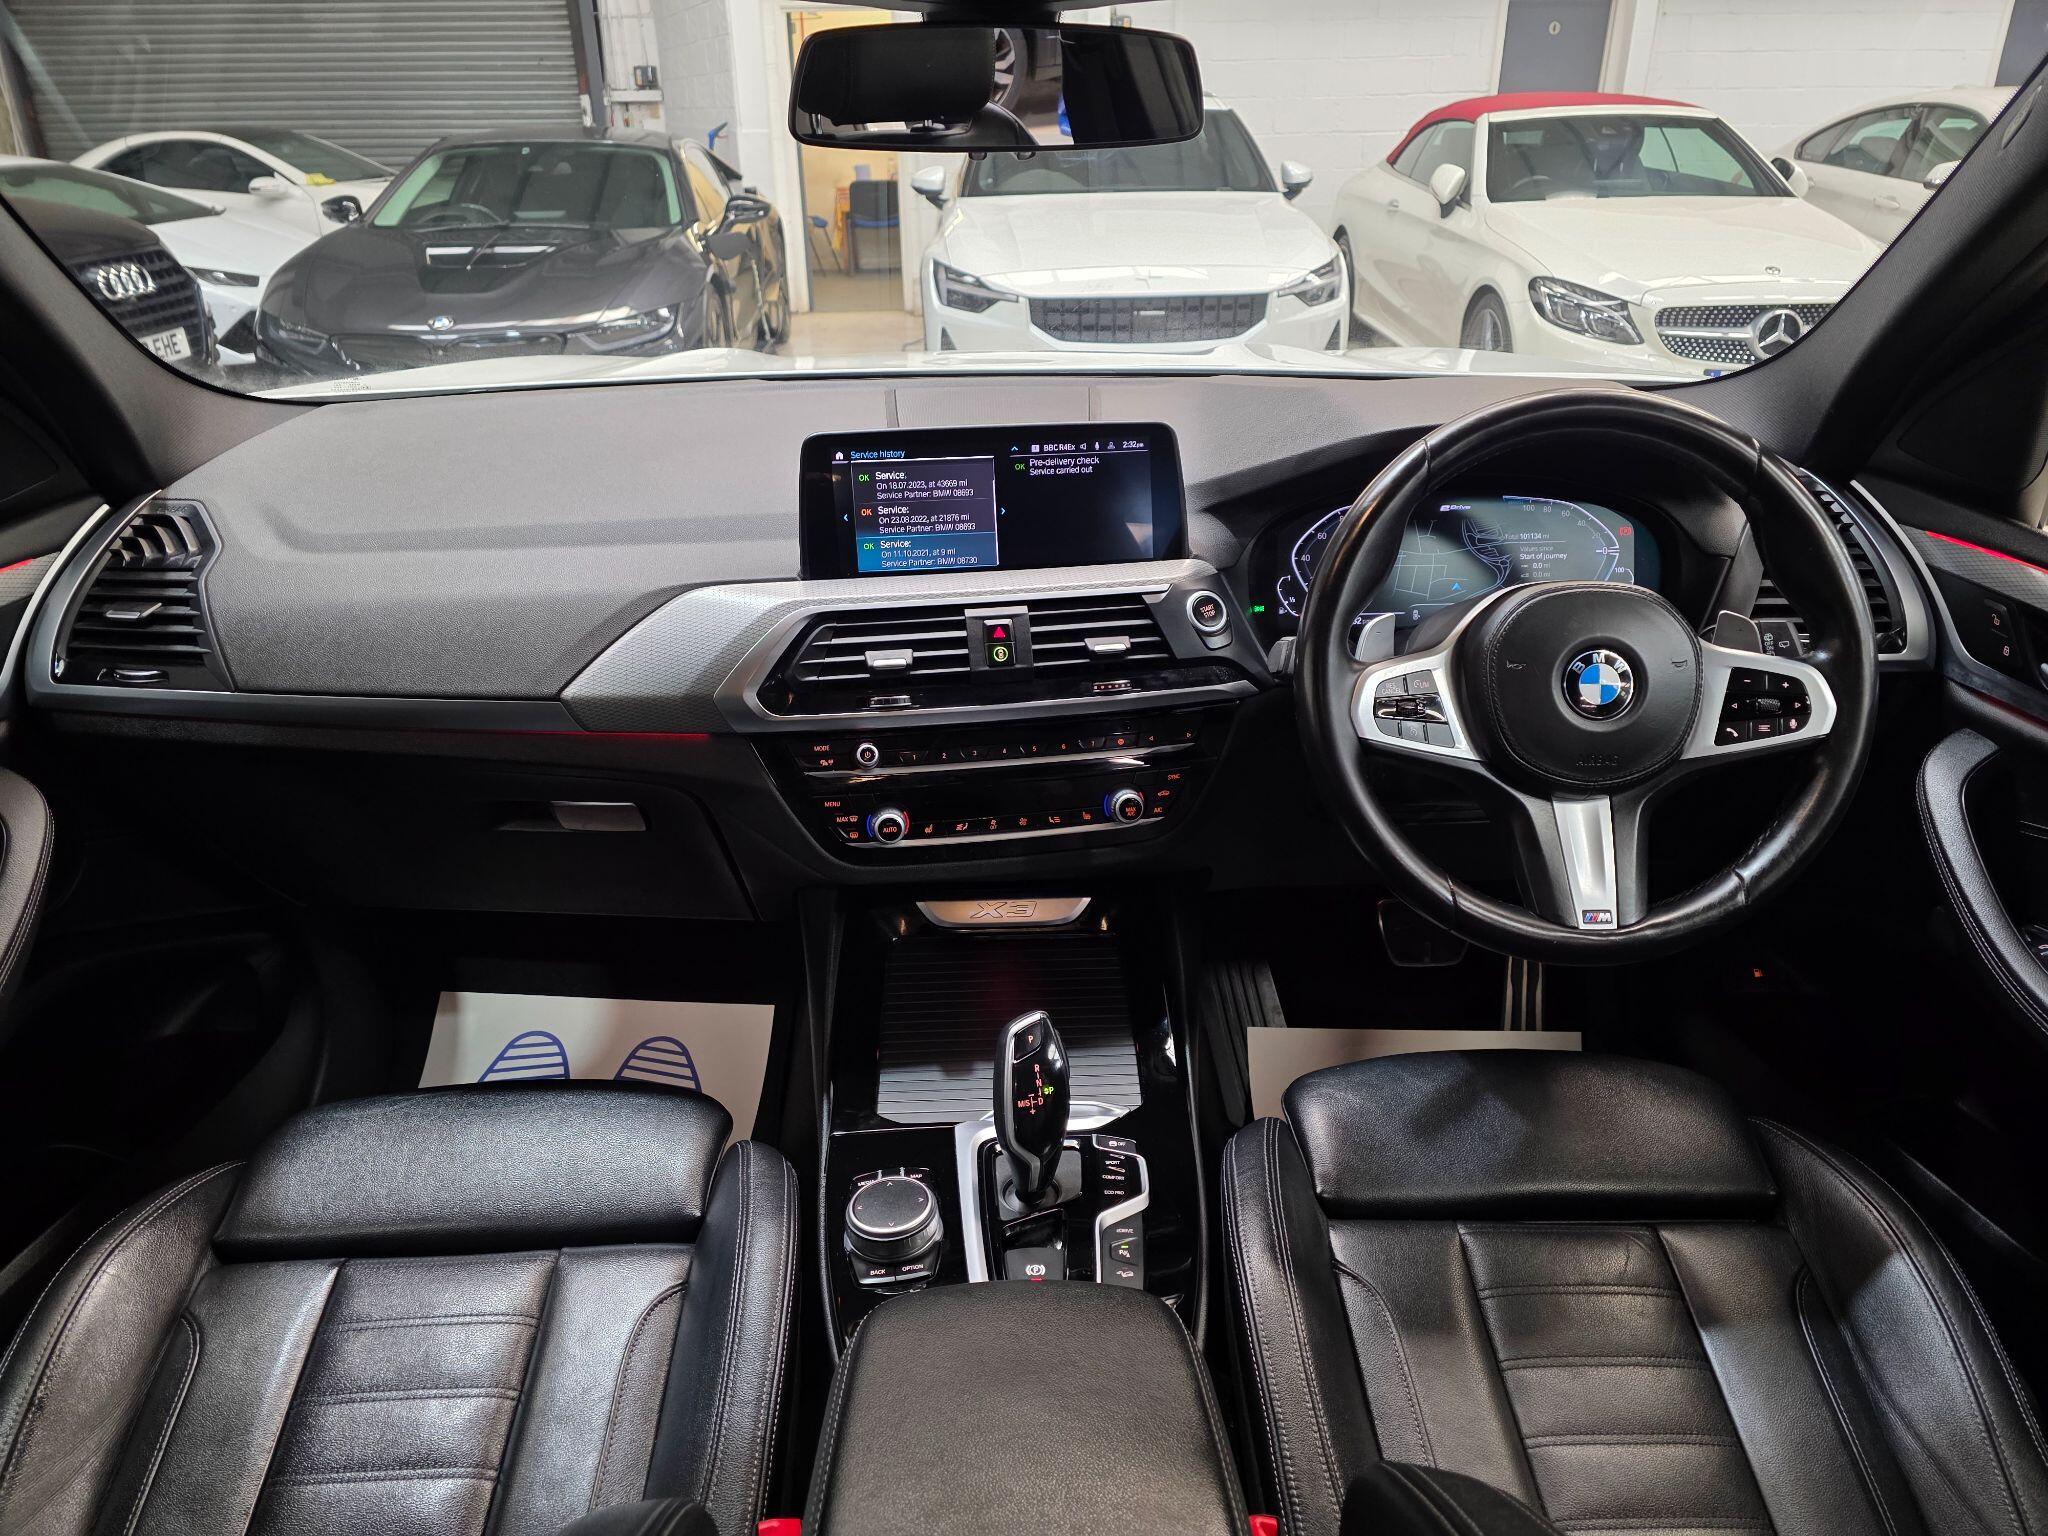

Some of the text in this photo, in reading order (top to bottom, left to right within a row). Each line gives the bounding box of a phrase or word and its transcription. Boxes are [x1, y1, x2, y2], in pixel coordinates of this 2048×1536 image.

[1043, 443, 1059, 452] BBC
[850, 449, 906, 459] Service history
[1029, 456, 1100, 467] Pre-delivery check
[1014, 463, 1026, 471] OK
[1029, 465, 1093, 476] Service carried out
[858, 474, 870, 482] OK
[875, 471, 907, 480] Service:
[876, 482, 888, 490] On
[928, 480, 936, 488] at
[958, 478, 968, 487] mi
[876, 491, 903, 500] Service
[932, 489, 952, 498] BMW
[861, 508, 873, 516] OK
[877, 505, 910, 515] Service:
[1522, 504, 1535, 512] 100
[1543, 505, 1552, 513] 80
[1561, 509, 1570, 517] 60
[878, 517, 891, 525] On
[960, 512, 970, 521] mi
[1577, 519, 1586, 527] 40
[879, 525, 904, 534] Service
[934, 524, 954, 532] BMW
[1317, 532, 1327, 540] 60
[863, 542, 875, 550] OK
[880, 540, 912, 549] Service:
[881, 551, 892, 559] On
[932, 548, 940, 556] at
[947, 547, 956, 555] mi
[1602, 546, 1608, 555] 0
[1300, 554, 1311, 562] 40
[1535, 552, 1543, 560] of
[1543, 552, 1568, 562] journey
[881, 559, 908, 568] Service
[937, 557, 956, 566] BMW
[1614, 566, 1625, 574] 100
[1199, 603, 1215, 613] START
[1203, 609, 1216, 619] STOP
[1571, 652, 1627, 674] BMW
[813, 744, 831, 752] MODE
[882, 826, 898, 834] AUTO
[969, 900, 1038, 919] X3
[869, 1268, 886, 1276] BACK
[901, 1263, 924, 1272] OPTION
